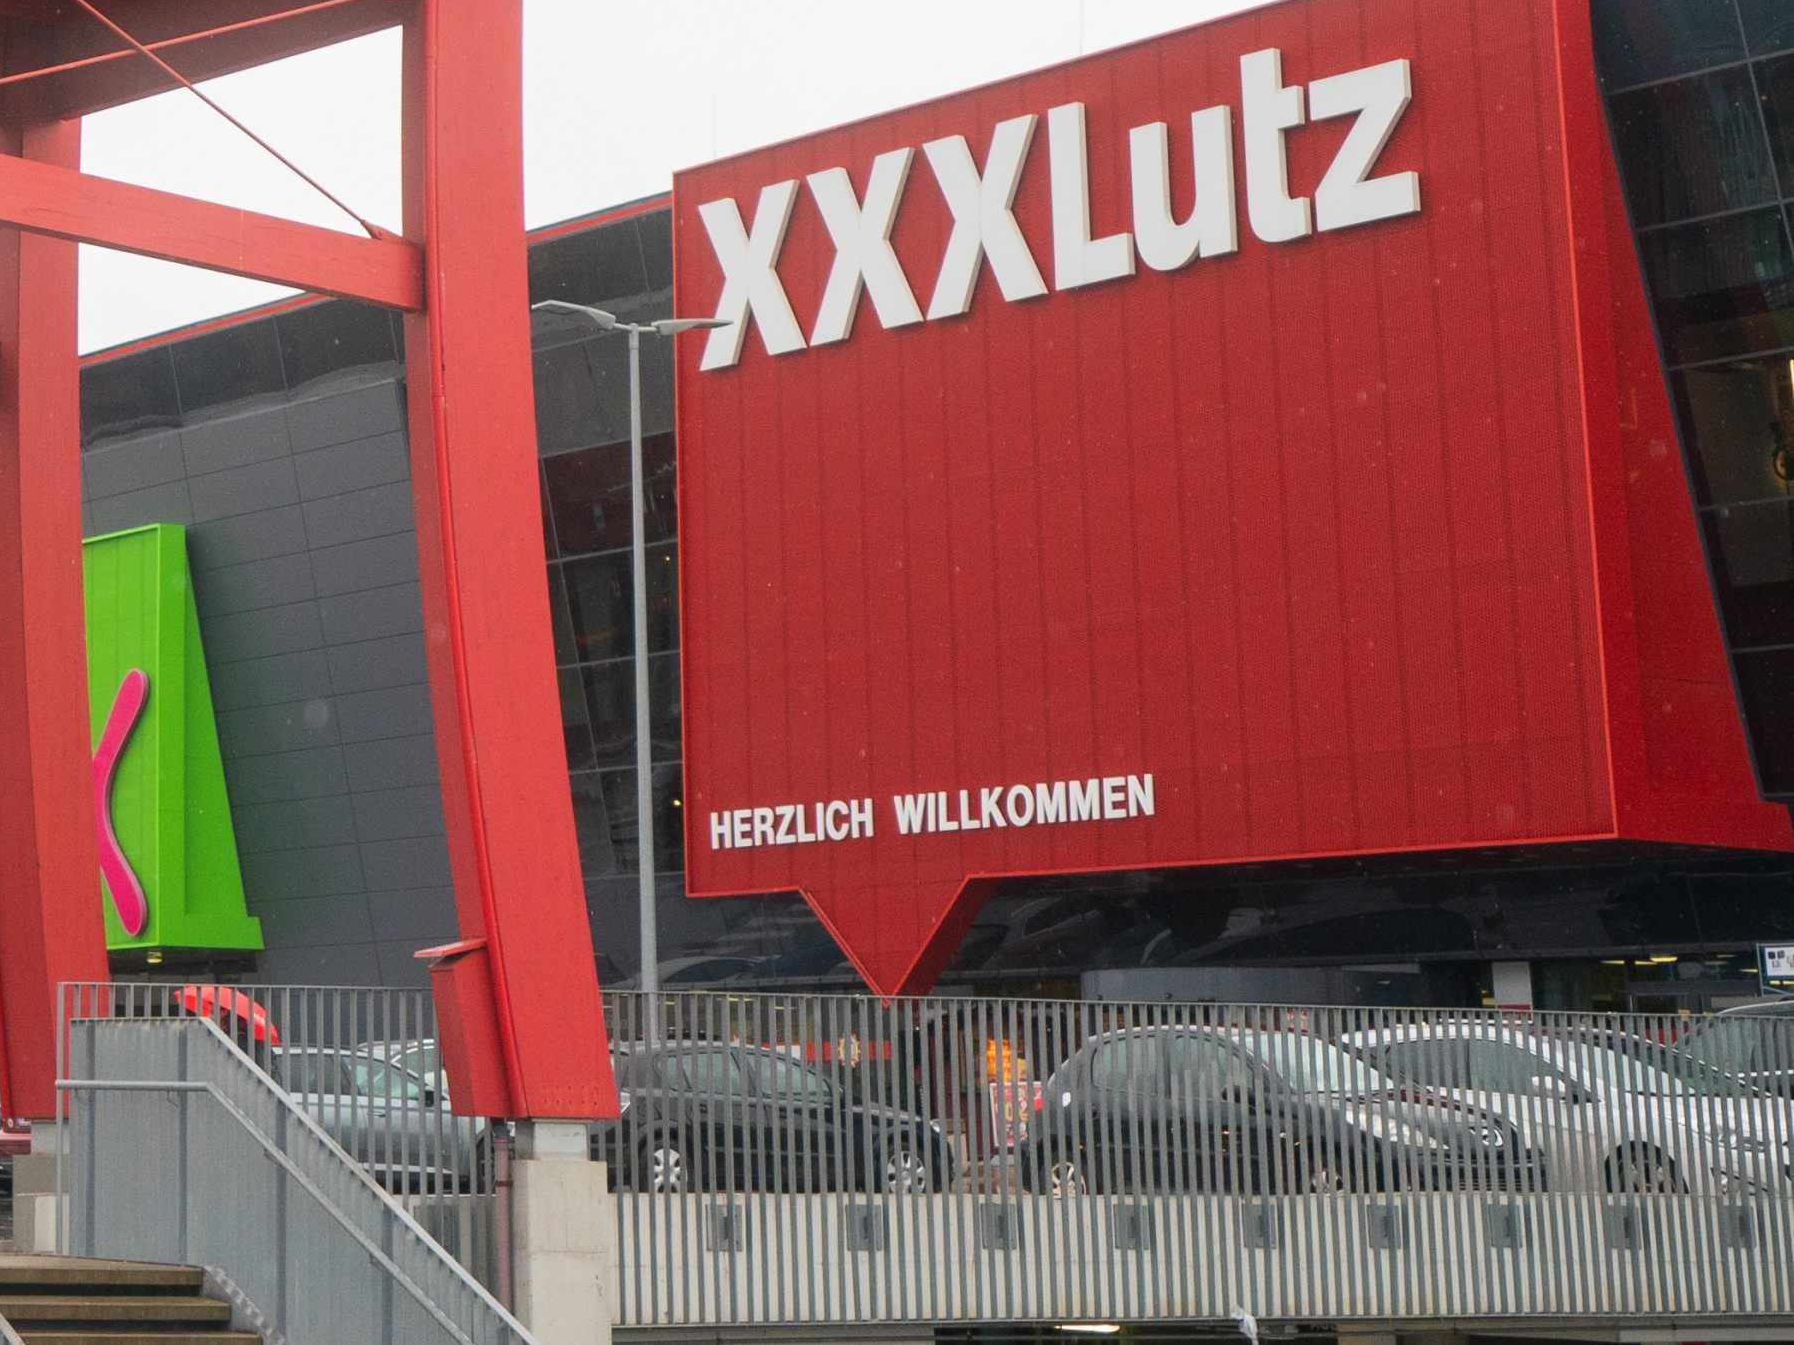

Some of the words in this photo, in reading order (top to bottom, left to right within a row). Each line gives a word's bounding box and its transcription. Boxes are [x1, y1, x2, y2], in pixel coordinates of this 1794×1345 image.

[698, 48, 1421, 371] XXXLutz
[710, 798, 874, 849] HERZLICH
[893, 773, 1155, 835] WILLKOMMEN
